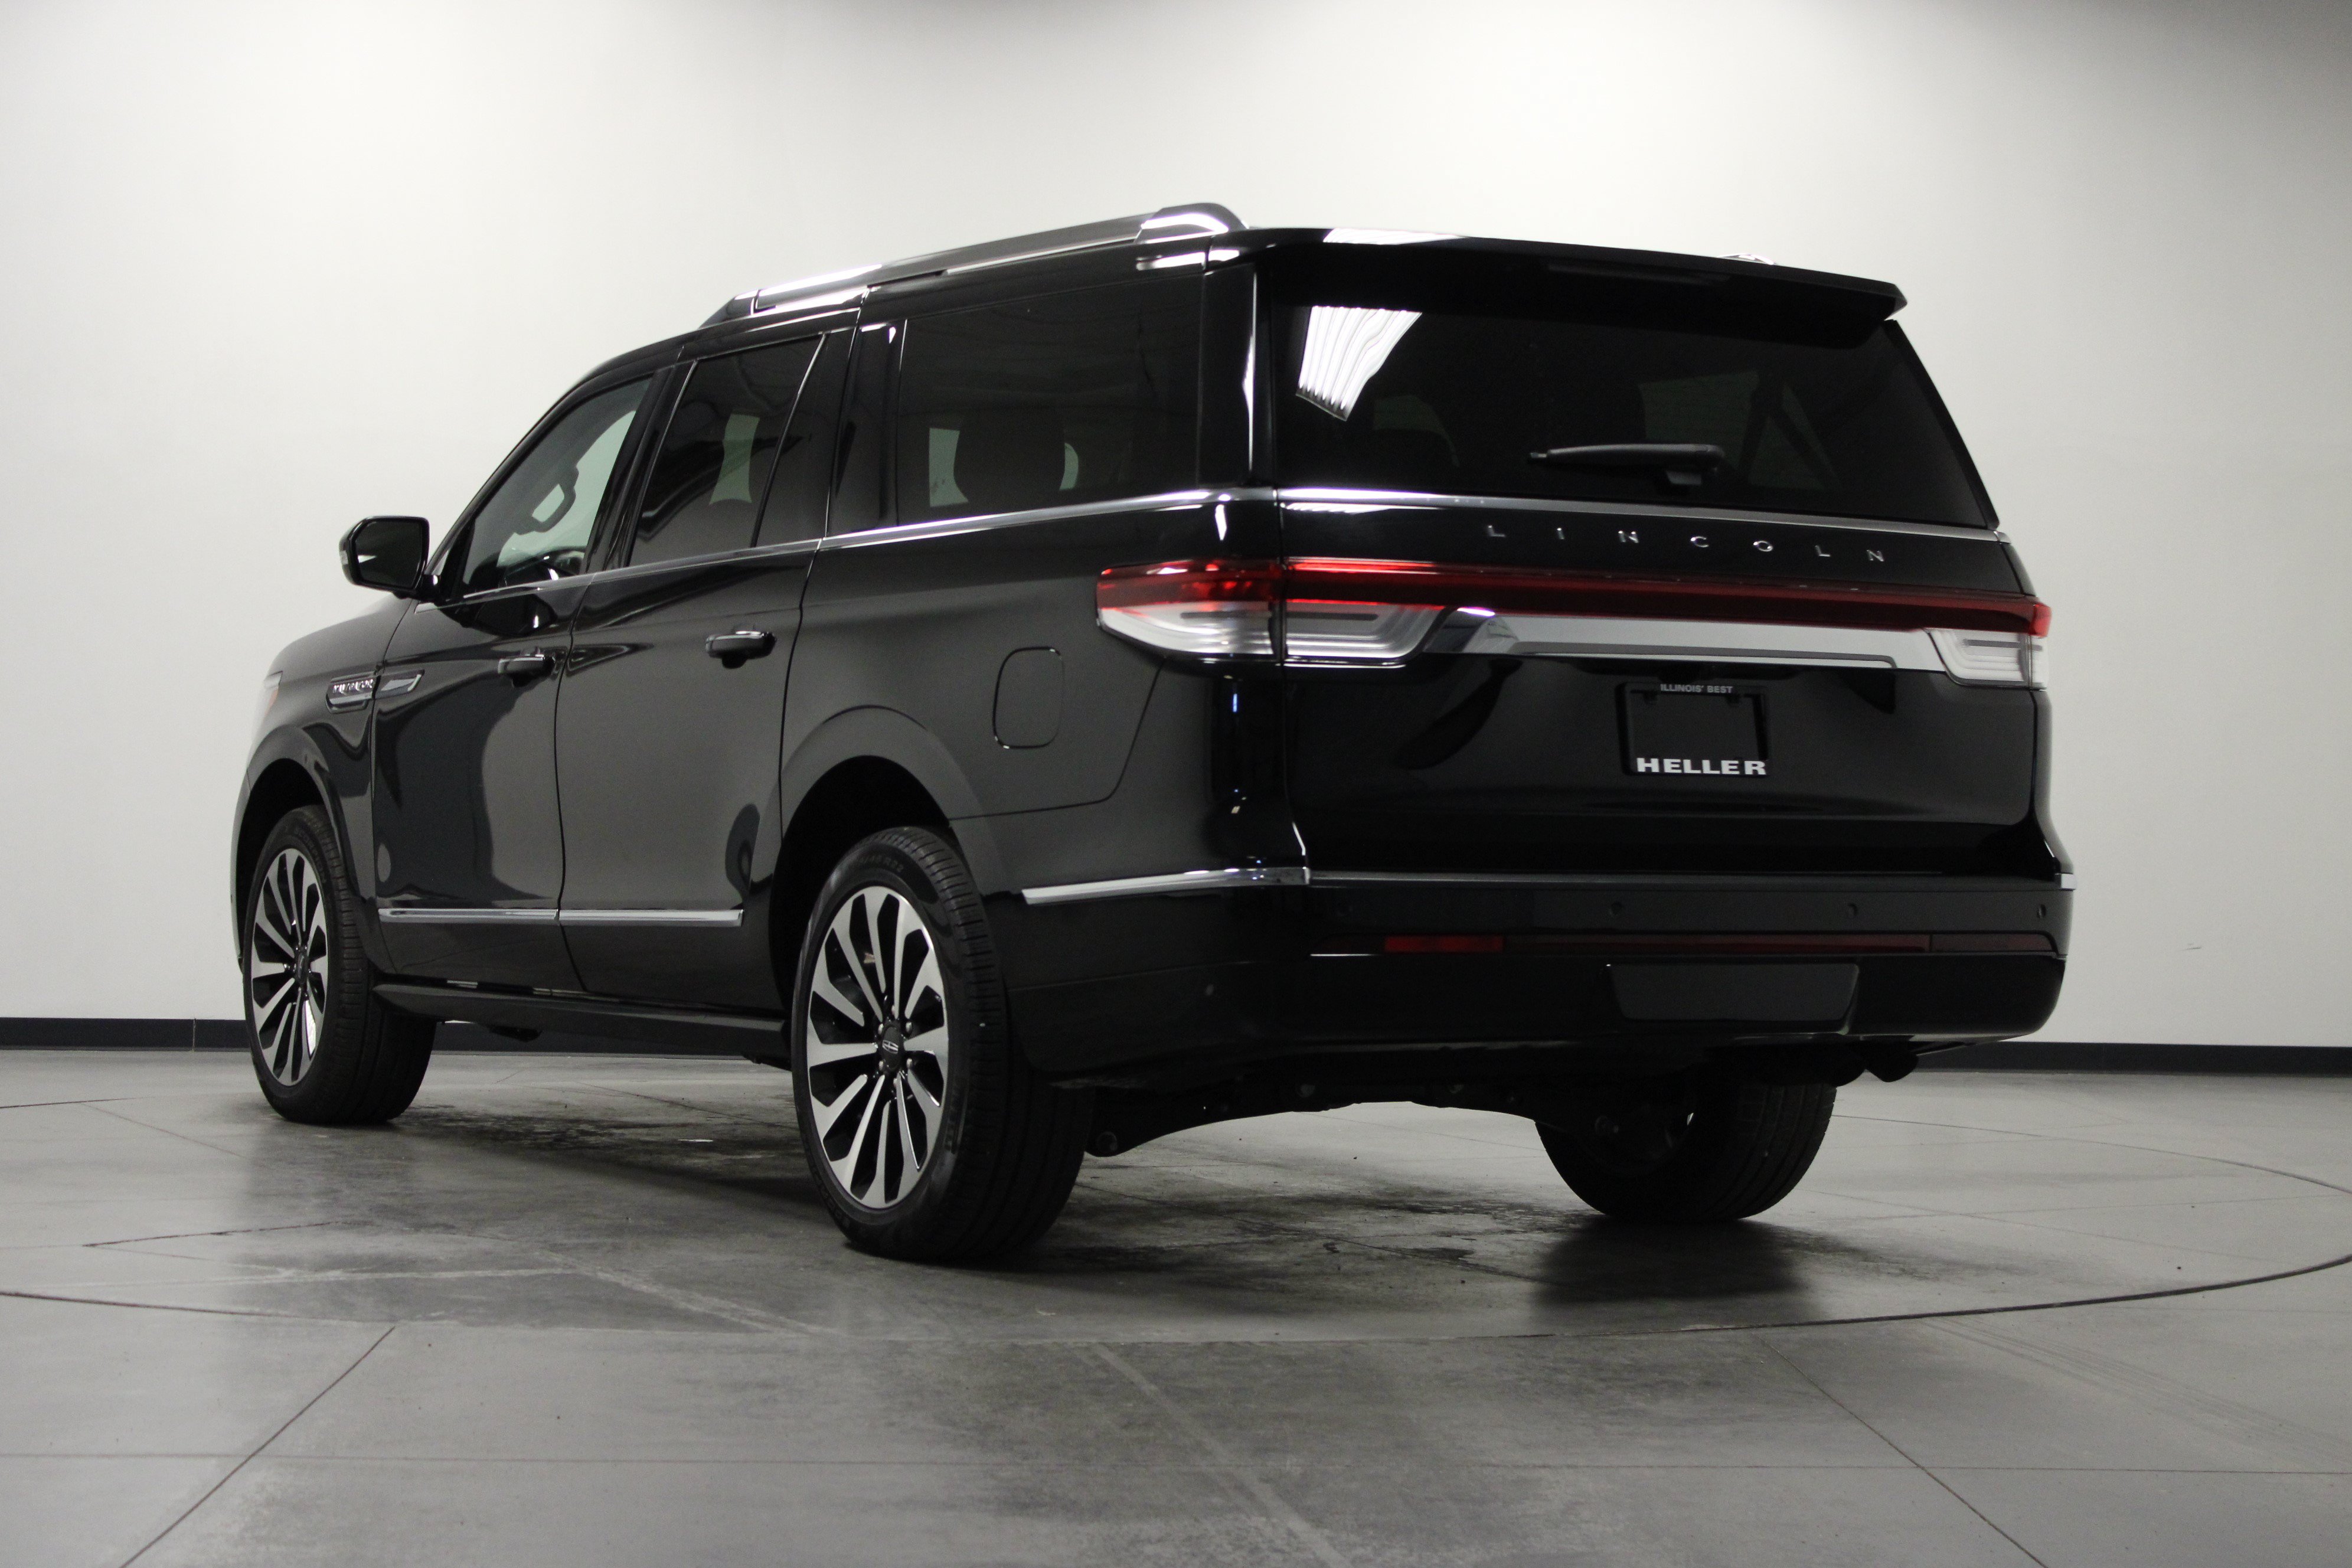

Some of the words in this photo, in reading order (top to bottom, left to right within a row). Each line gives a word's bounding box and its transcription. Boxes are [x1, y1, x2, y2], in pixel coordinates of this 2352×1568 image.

[1486, 525, 1884, 562] LINCOLN
[1660, 684, 1704, 693] ILLINOIS'
[1707, 685, 1733, 694] BEST
[1636, 758, 1766, 775] HELLER
